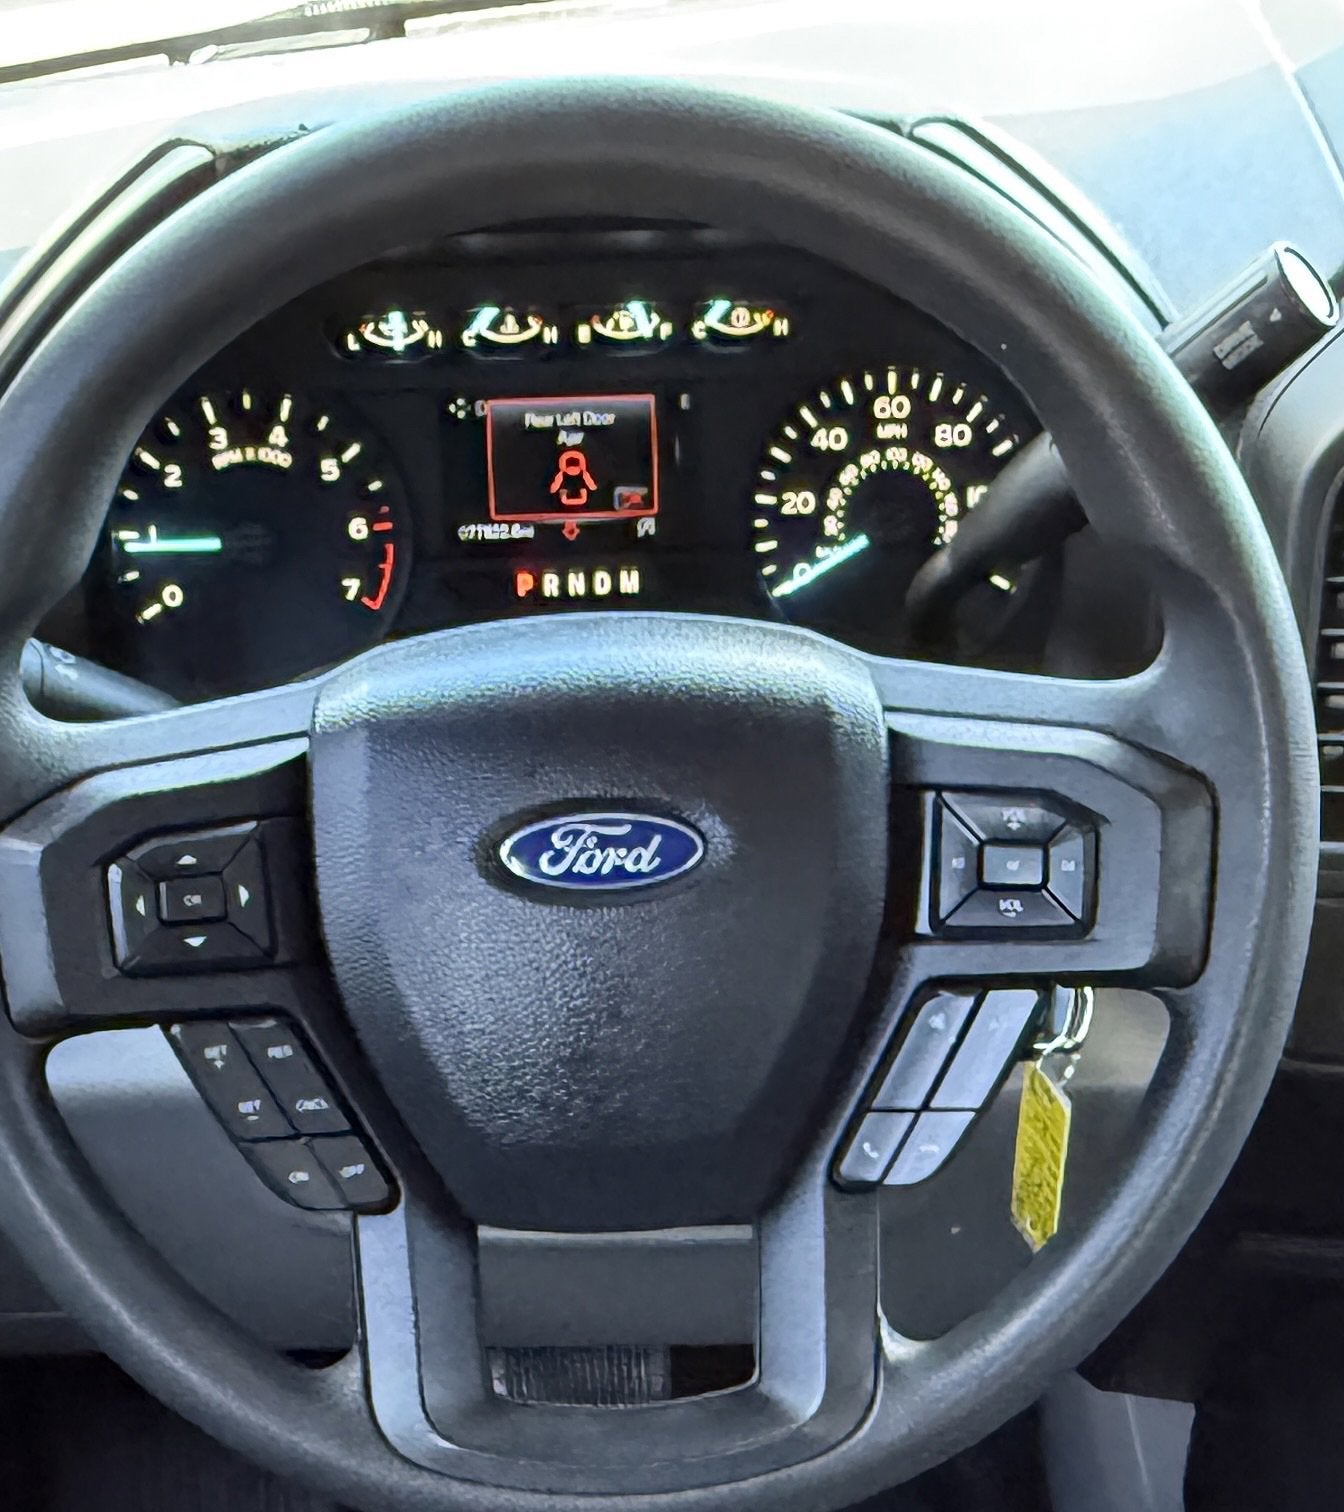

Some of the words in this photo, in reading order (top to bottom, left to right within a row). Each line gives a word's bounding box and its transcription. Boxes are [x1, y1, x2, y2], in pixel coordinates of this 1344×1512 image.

[873, 395, 911, 419] 60
[208, 426, 228, 449] 3
[268, 425, 289, 447] 4
[810, 426, 849, 451] 40
[934, 423, 972, 448] 80
[163, 463, 183, 487] 2
[320, 458, 341, 481] 5
[780, 491, 816, 515] 20
[348, 516, 369, 540] 6
[341, 577, 361, 601] 7
[516, 572, 534, 597] P
[543, 571, 560, 597] R
[567, 571, 586, 596] N
[593, 569, 612, 595] D
[619, 568, 640, 593] M
[161, 584, 184, 608] 0
[538, 823, 663, 876] Ford
